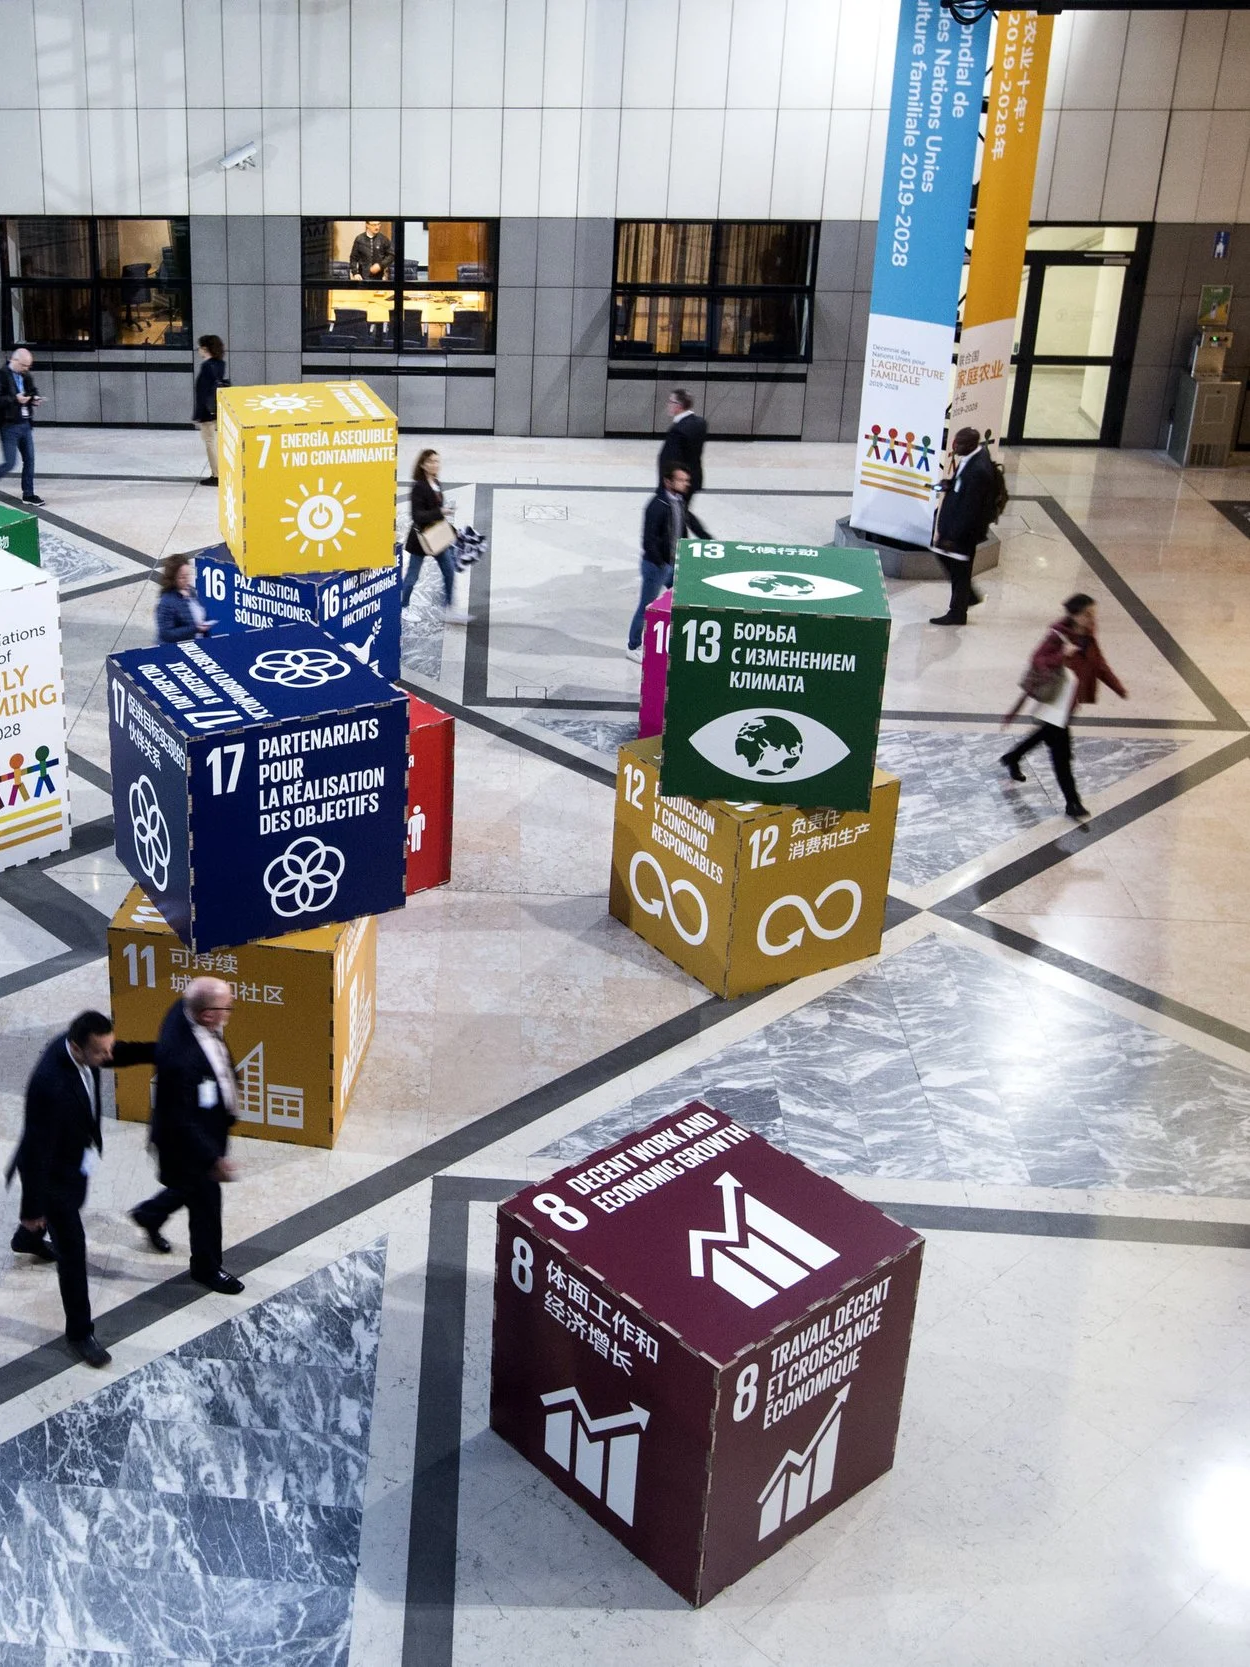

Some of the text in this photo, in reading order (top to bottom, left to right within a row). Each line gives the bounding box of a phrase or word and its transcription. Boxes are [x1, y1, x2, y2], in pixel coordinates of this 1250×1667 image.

[921, 48, 952, 194] Nations Unies
[952, 91, 970, 119] de
[891, 61, 928, 268] familiale 2019-2028
[870, 368, 921, 387] FAMILIALE
[957, 359, 1004, 389] 家庭农业
[256, 434, 272, 469] 7
[281, 428, 394, 449] ENERGÍA ASEQUIBLE
[281, 446, 396, 468] Y NO CONTAMINANTE
[687, 542, 725, 559] 13
[202, 565, 226, 601] 16
[234, 573, 300, 603] PAZ, JUSTICIA
[322, 584, 340, 622] 16
[343, 572, 398, 611] И ЭФФЕКТИВНЫЕ
[234, 590, 312, 623] E INSTITUCIONES
[234, 605, 274, 628] SÓLIDAS
[342, 598, 381, 629] ИНСТИТУТЫ
[681, 618, 722, 664] 13
[733, 622, 797, 644] БОРЬБА
[177, 641, 275, 721] УСТОЙЧИВОГО РАЗВИТИЯ
[731, 647, 856, 673] С ИЗМЕНЕНИЕМ
[112, 677, 126, 729] 17
[137, 664, 197, 710] ПАРТНЕРСТВО
[166, 661, 224, 705] В ИНТЕРЕСАХ
[729, 671, 805, 693] КЛИМАТА
[184, 709, 244, 729] 17
[258, 718, 380, 761] PARTENARIATS
[206, 742, 246, 797] 17
[258, 757, 305, 786] POUR
[259, 766, 385, 812] LA RÉALISATION
[623, 763, 646, 811] 12
[259, 793, 380, 836] DES OBJECTIFS
[654, 801, 661, 820] Y
[662, 808, 708, 852] CONSUMO
[651, 822, 724, 885] RESPONSABLES
[748, 824, 780, 870] 12
[788, 823, 871, 862] 消费和生产
[122, 943, 157, 988] 11
[169, 947, 238, 975] 可持续
[566, 1111, 718, 1196] DECENT WORK AND
[590, 1123, 752, 1214] ECONOMIC GROWTH
[532, 1192, 589, 1232] 8
[511, 1235, 535, 1294] 8
[546, 1259, 659, 1363] 体面工作和
[770, 1275, 892, 1373] TRAVAIL DÉCENT
[543, 1290, 634, 1377] 经济增长
[766, 1308, 884, 1402] ET CROISSANCE
[732, 1362, 759, 1423] 8
[763, 1345, 862, 1430] ÉCONOMIQUE
